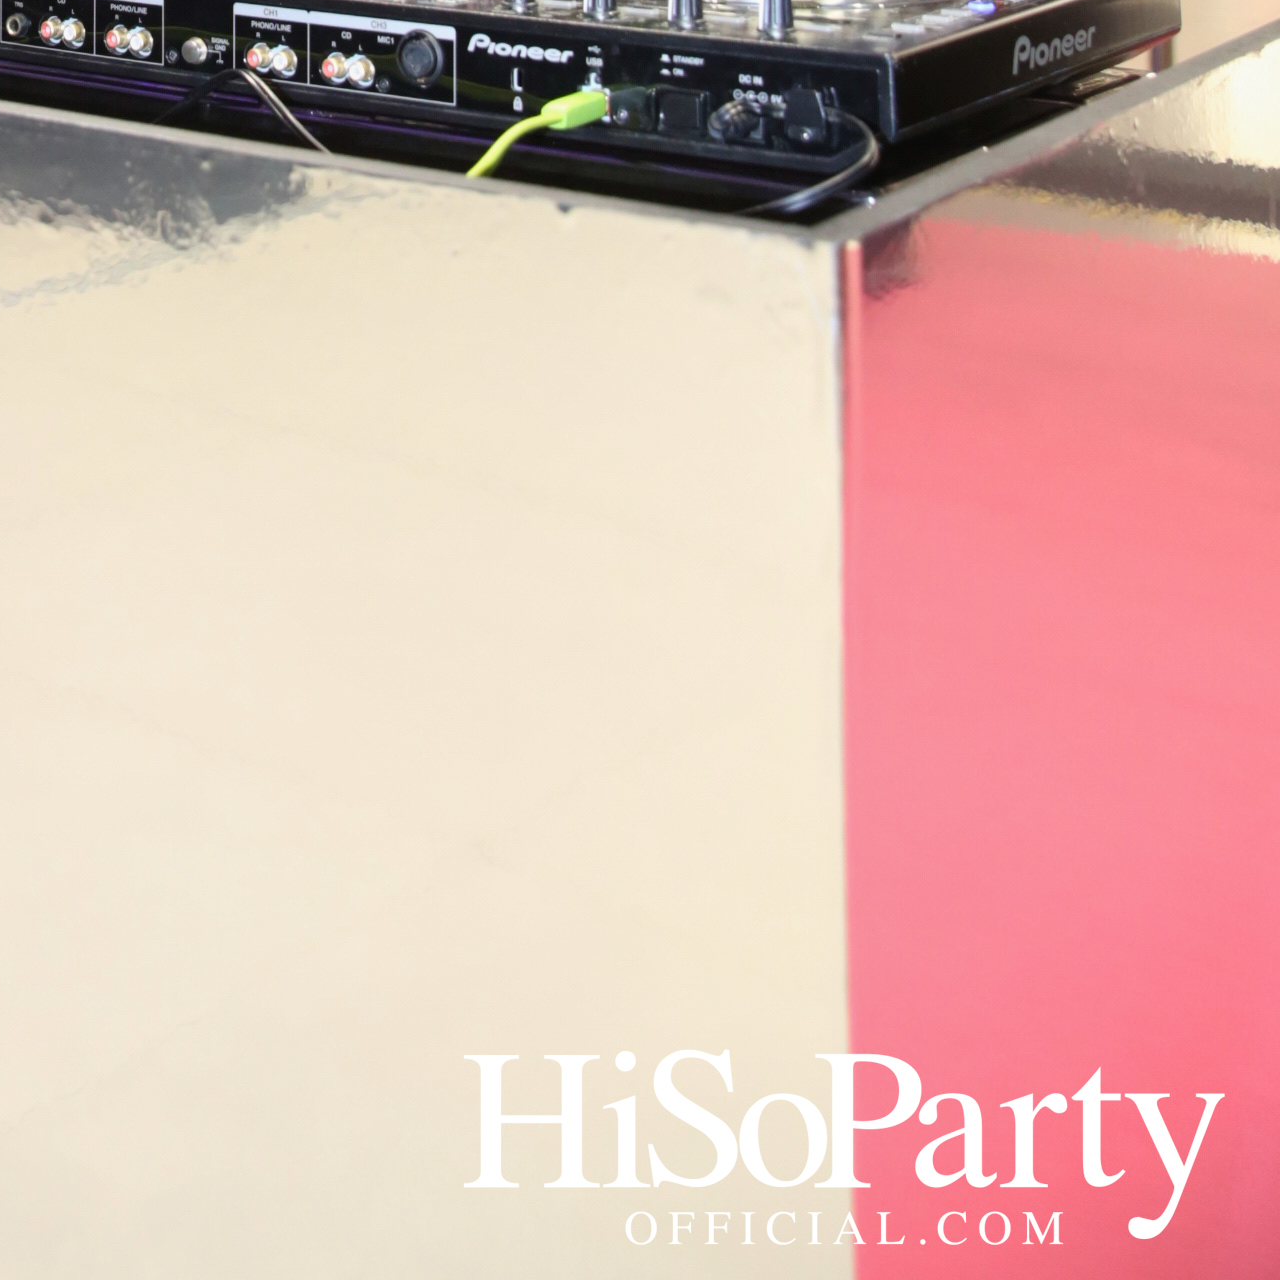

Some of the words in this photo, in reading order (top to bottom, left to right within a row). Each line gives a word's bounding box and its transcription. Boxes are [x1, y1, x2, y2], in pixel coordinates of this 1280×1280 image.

[110, 3, 148, 15] PHONO/LINE
[263, 8, 279, 17] CH1
[251, 20, 292, 33] PHONO/LINE
[371, 20, 388, 30] CH3
[341, 31, 352, 40] CD
[377, 35, 395, 45] MIC1
[467, 33, 574, 64] Pioneer
[1012, 25, 1096, 76] Pioneer
[586, 56, 603, 67] USB
[672, 55, 705, 66] STANDBY
[672, 68, 685, 77] ON
[738, 74, 751, 84] DC
[752, 76, 764, 86] IN
